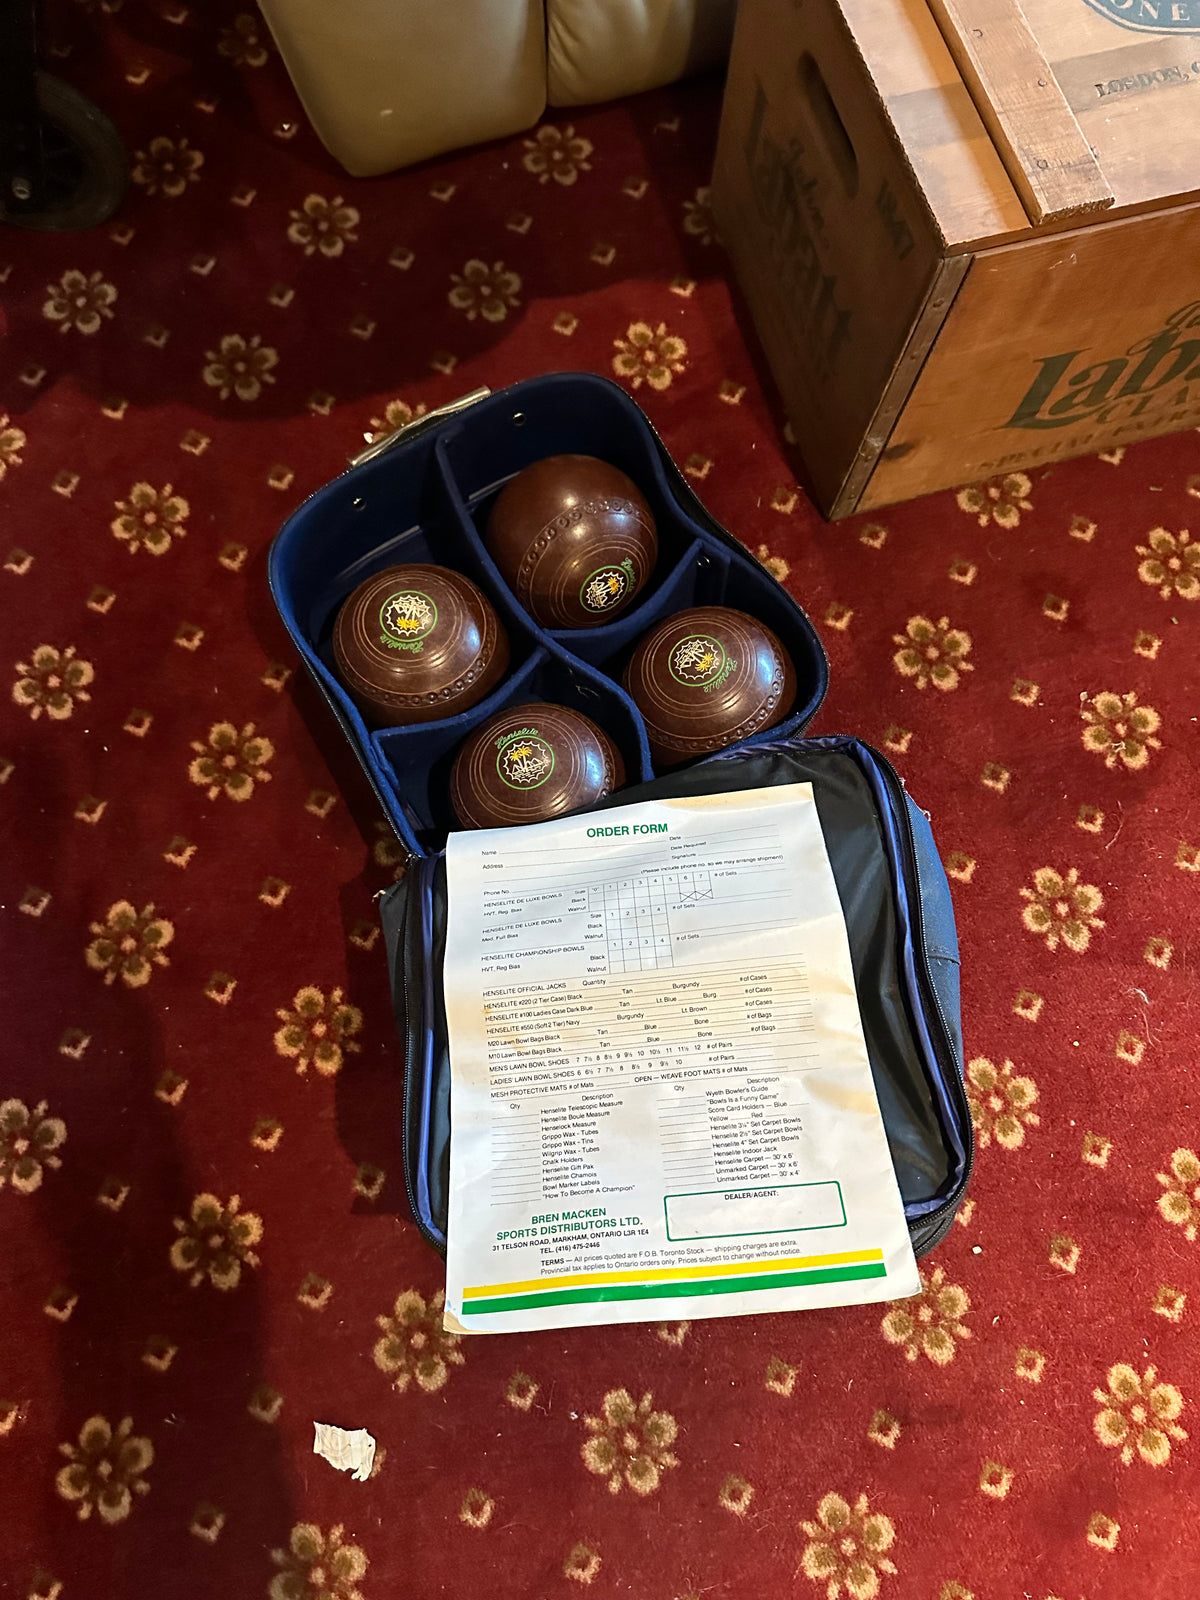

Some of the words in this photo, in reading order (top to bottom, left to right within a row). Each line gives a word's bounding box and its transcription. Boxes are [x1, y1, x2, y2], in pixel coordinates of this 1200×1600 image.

[993, 331, 1200, 430] Lab
[494, 727, 539, 749] Henselite
[587, 826, 629, 838] ORDER
[633, 823, 668, 834] FORM
[483, 926, 514, 934] HENSELITE
[516, 947, 562, 958] CHAMPIONSHIP
[487, 1026, 519, 1034] HENSELITE
[617, 1012, 644, 1021] Burgundy
[510, 1087, 548, 1096] PROTECTIVE
[582, 1092, 613, 1101] Description
[725, 1190, 779, 1200] DEALER/AGENT:
[532, 1214, 559, 1224] BREN
[562, 1208, 606, 1220] MACKEN
[497, 1228, 537, 1241] SPORTS
[541, 1219, 616, 1234] DISTRIBUTORS
[620, 1217, 642, 1226] LTD.
[502, 1241, 528, 1250] TELSON
[552, 1234, 589, 1243] MARKHAM,
[590, 1231, 622, 1239] ONTARIO
[555, 1245, 571, 1253] (416)
[572, 1242, 600, 1250] 475-2446
[541, 1258, 564, 1266] TERMS
[714, 1245, 741, 1253] shipping
[541, 1266, 570, 1275] Provincial
[583, 1262, 605, 1270] applies
[615, 1259, 638, 1268] Ontario
[699, 1254, 722, 1263] subject
[730, 1252, 754, 1261] change
[755, 1249, 779, 1257] without
